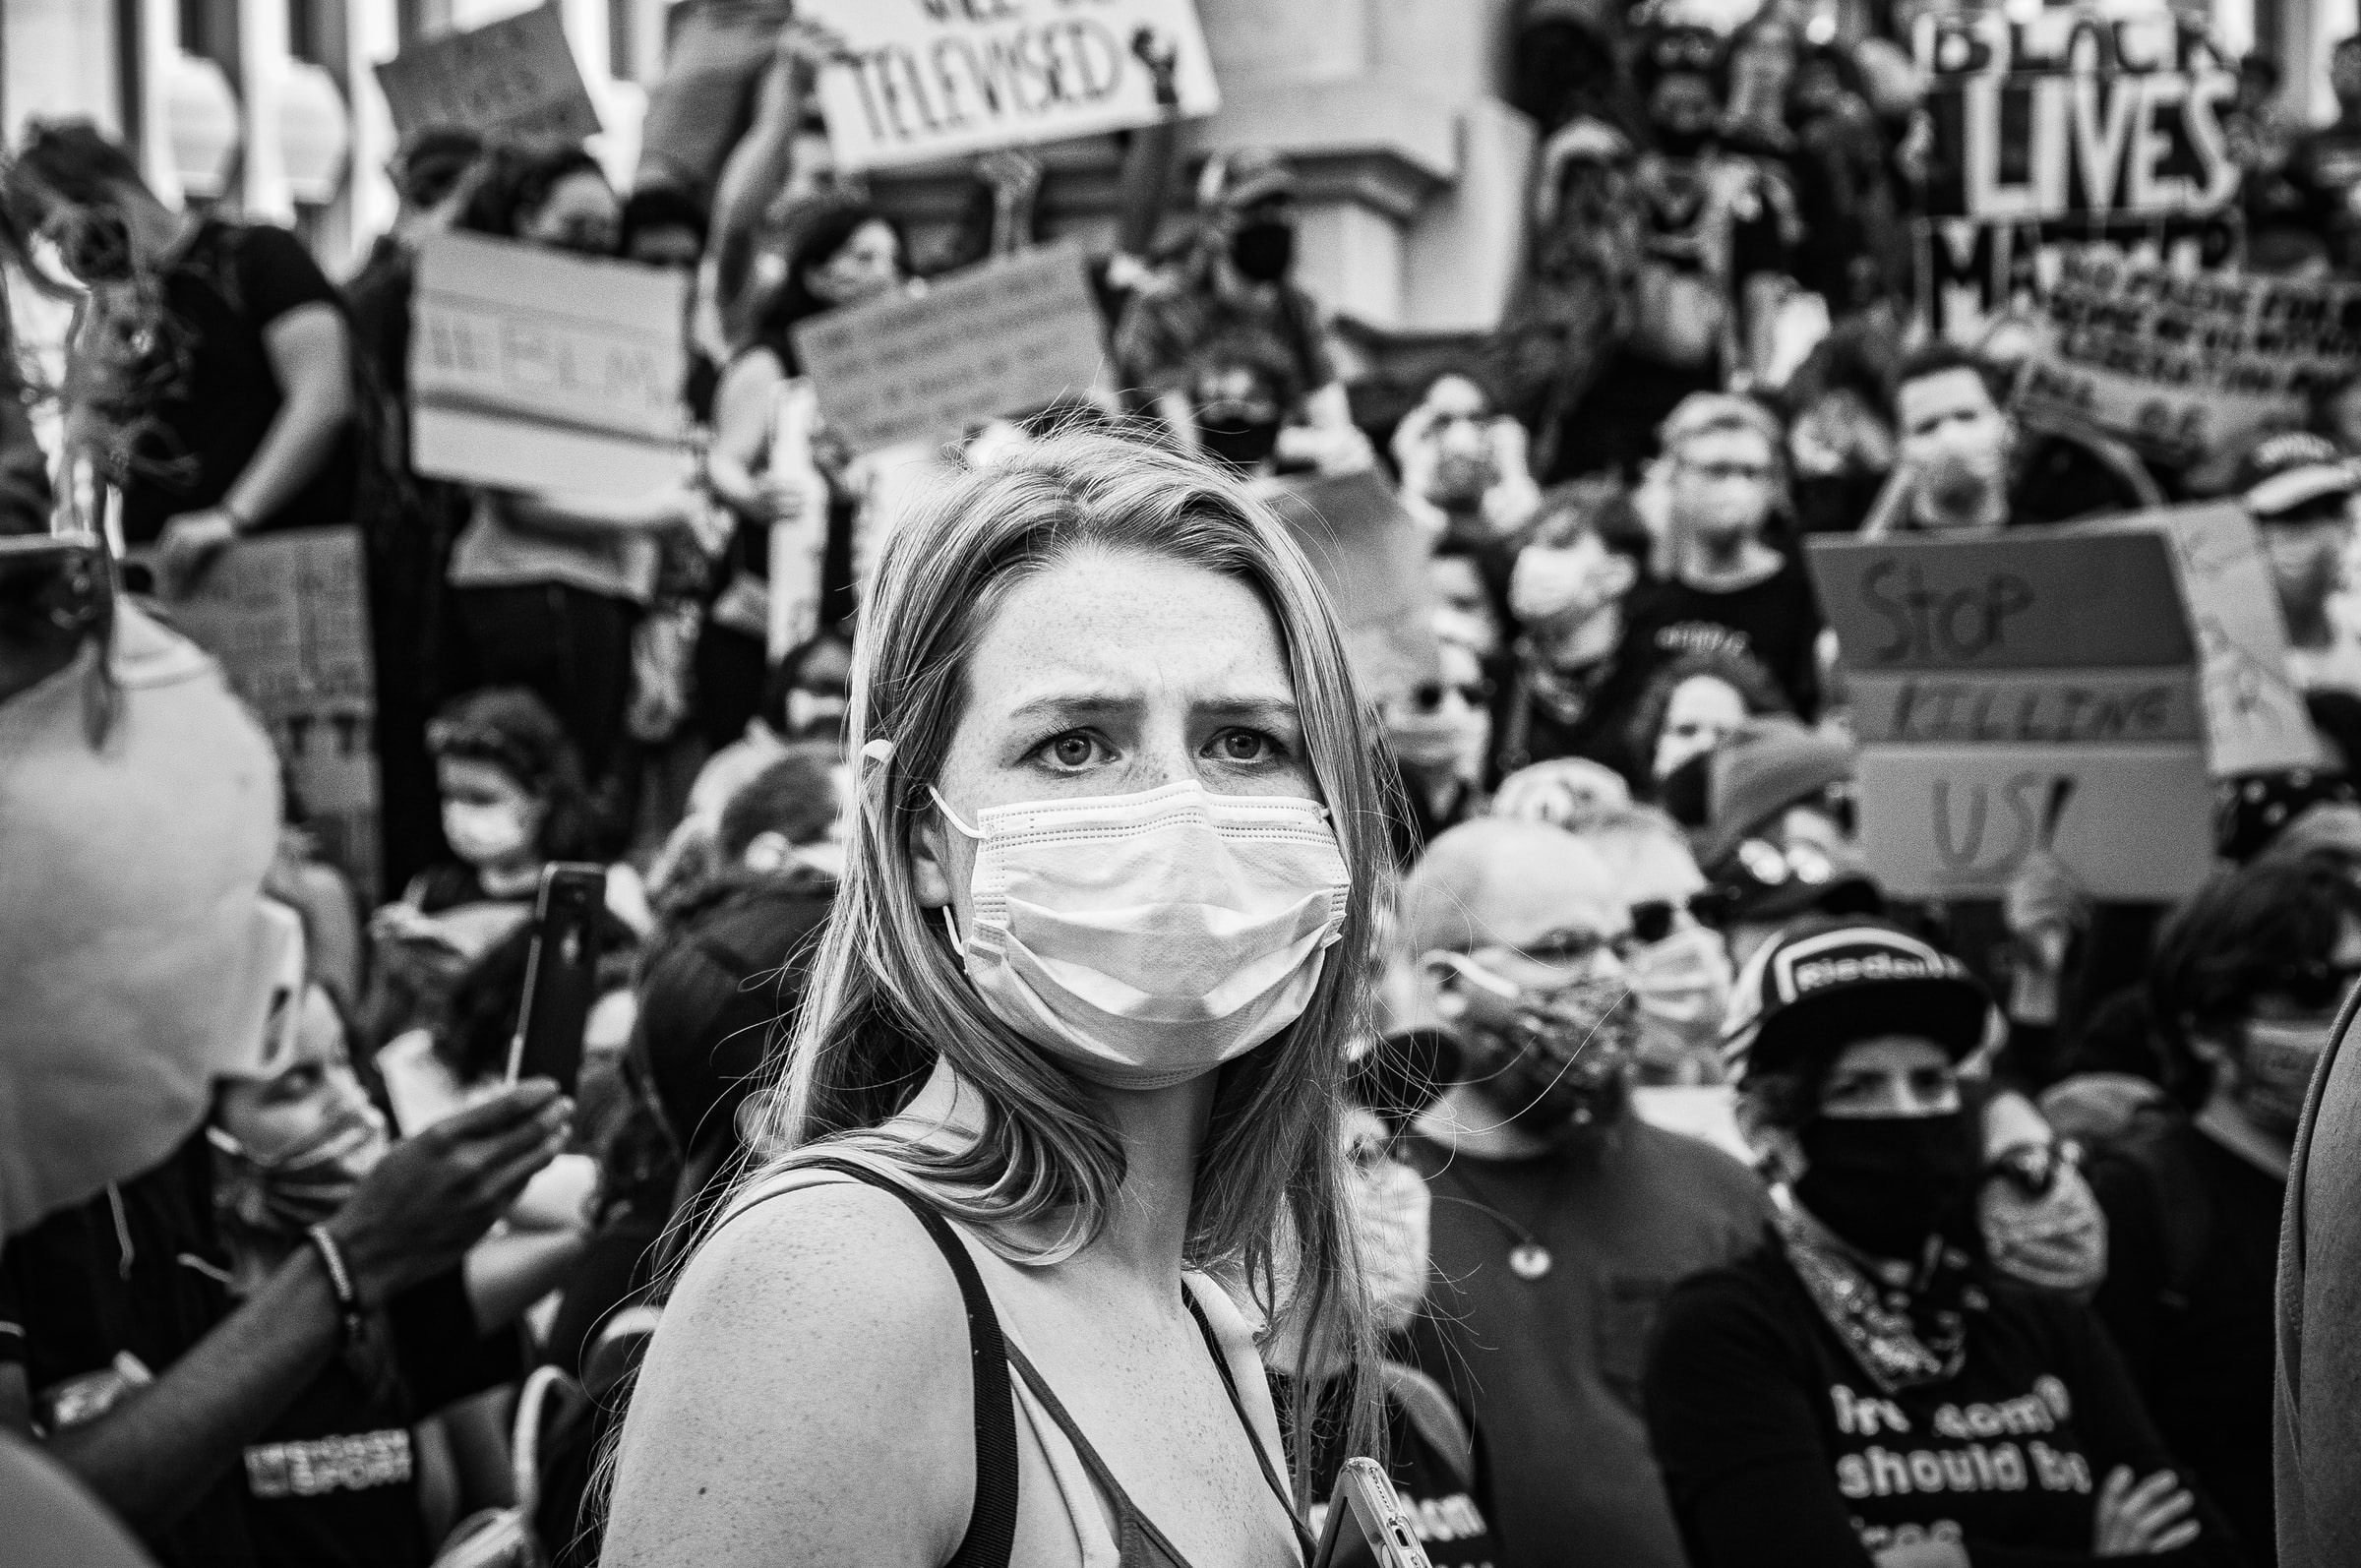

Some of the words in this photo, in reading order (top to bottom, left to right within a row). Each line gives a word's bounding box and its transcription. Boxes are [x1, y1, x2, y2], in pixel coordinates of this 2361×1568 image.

[1931, 14, 2229, 76] BLACK
[829, 20, 1123, 141] TELEVISED
[1964, 71, 2242, 218] LIVES
[1893, 679, 2165, 742] KILLING
[1836, 1442, 2028, 1498] should
